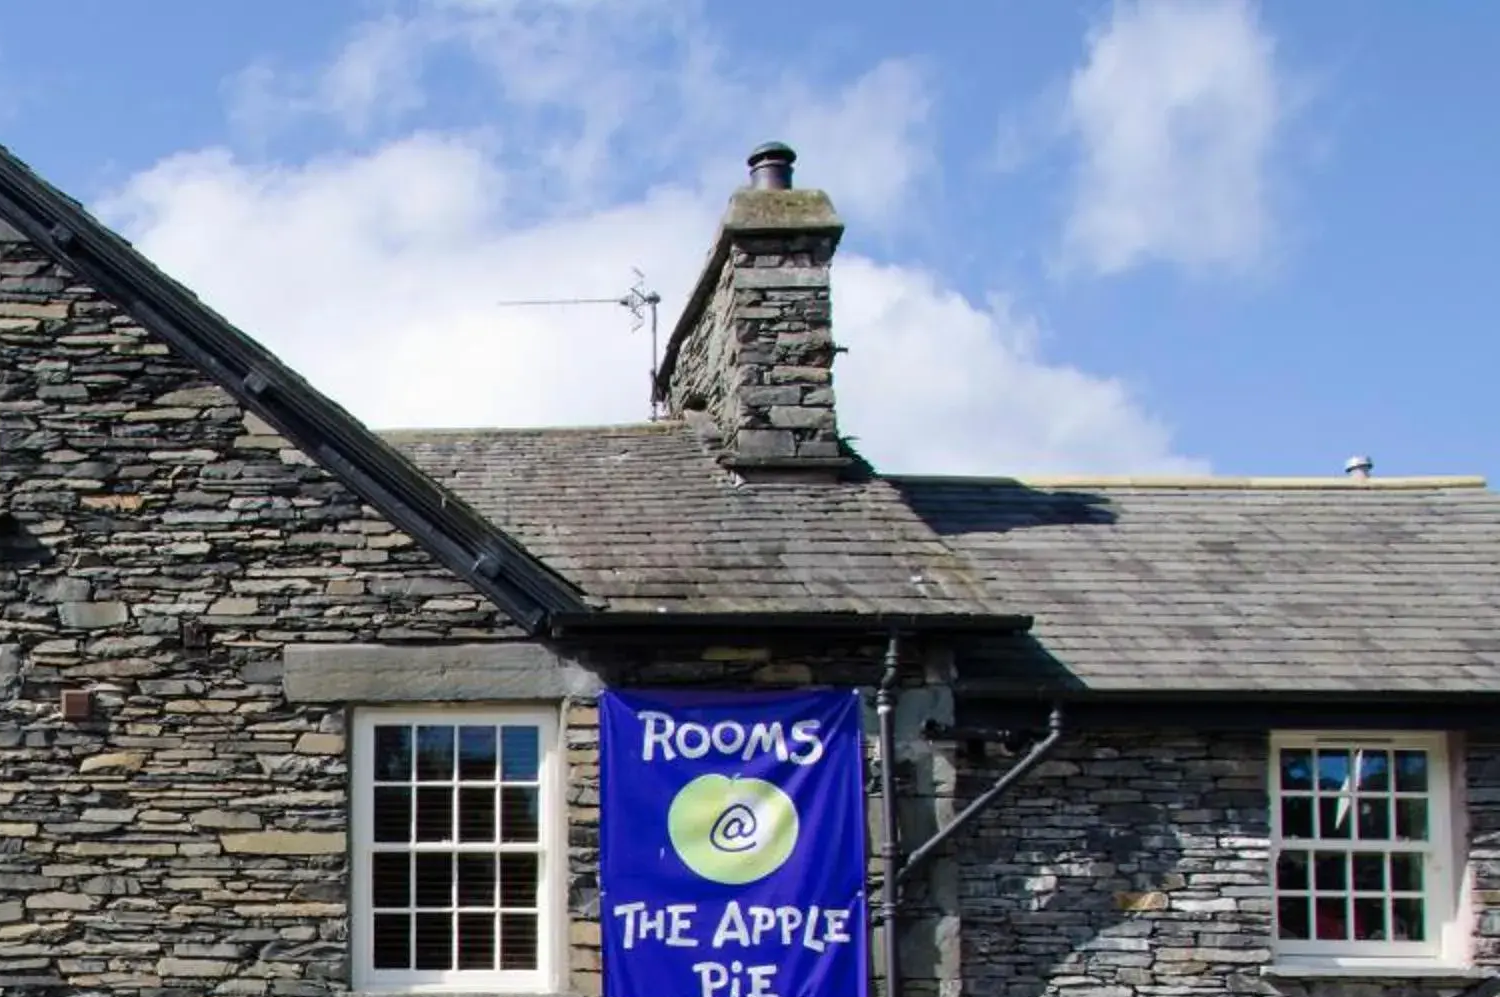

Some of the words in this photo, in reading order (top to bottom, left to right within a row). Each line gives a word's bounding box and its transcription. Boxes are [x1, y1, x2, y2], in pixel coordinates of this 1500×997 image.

[638, 711, 823, 765] ROOMS
[710, 803, 757, 852] @
[614, 902, 699, 949] THE
[711, 900, 851, 953] APPLE
